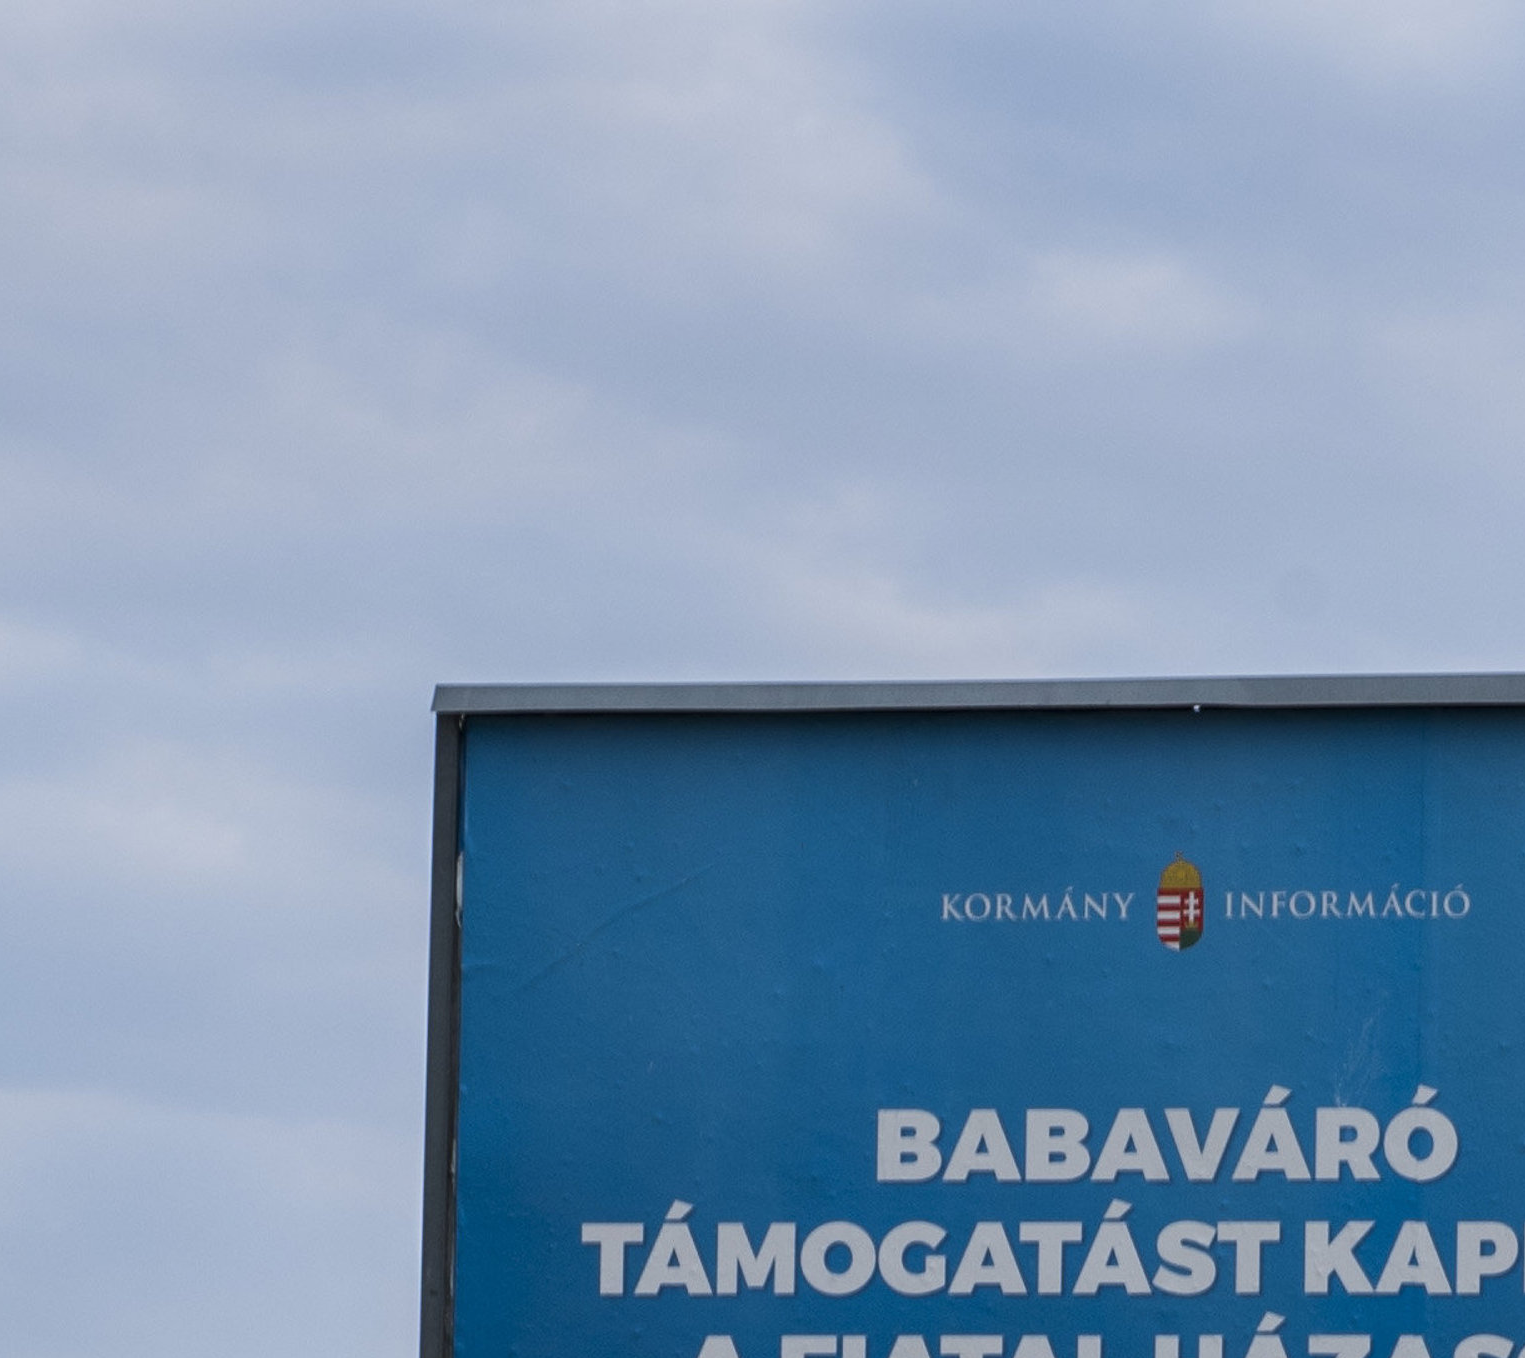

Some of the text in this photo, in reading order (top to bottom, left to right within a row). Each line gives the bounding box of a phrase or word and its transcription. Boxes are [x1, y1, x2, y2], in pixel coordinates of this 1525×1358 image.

[941, 883, 1472, 921] KORMÁNY INFORMÁCIÓ
[875, 1084, 1460, 1182] BABAVÁRÓ
[580, 1198, 1282, 1296] TÁMOGATÁST
